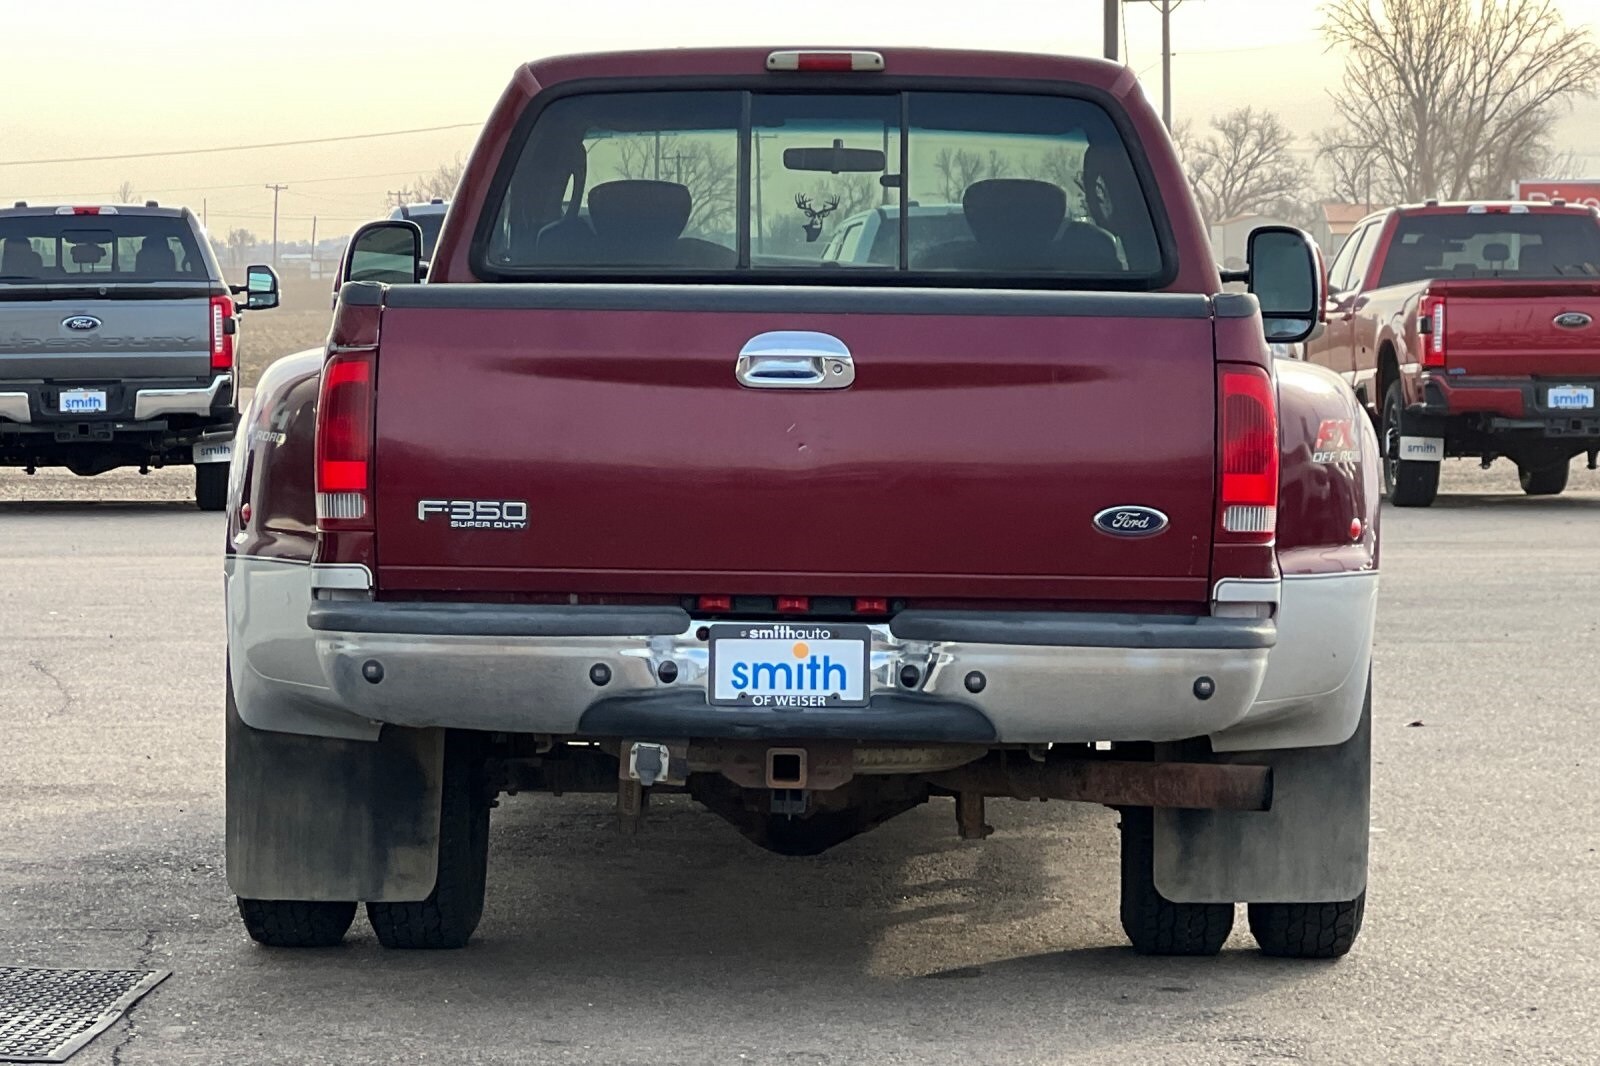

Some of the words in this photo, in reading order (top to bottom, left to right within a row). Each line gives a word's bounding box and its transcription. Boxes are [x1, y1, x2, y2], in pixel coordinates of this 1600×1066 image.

[71, 319, 93, 329] Ford
[0, 334, 95, 349] UPER
[102, 334, 196, 349] DUTY
[65, 392, 101, 408] smith
[1553, 390, 1589, 405] smith
[200, 444, 231, 456] smith
[1407, 443, 1437, 453] smith
[1312, 451, 1337, 462] OFF
[493, 521, 526, 529] DUTY
[1112, 511, 1150, 528] Ford
[749, 625, 831, 639] smithauto
[731, 643, 847, 690] smith
[752, 695, 772, 706] OF
[774, 695, 826, 707] WEISER
